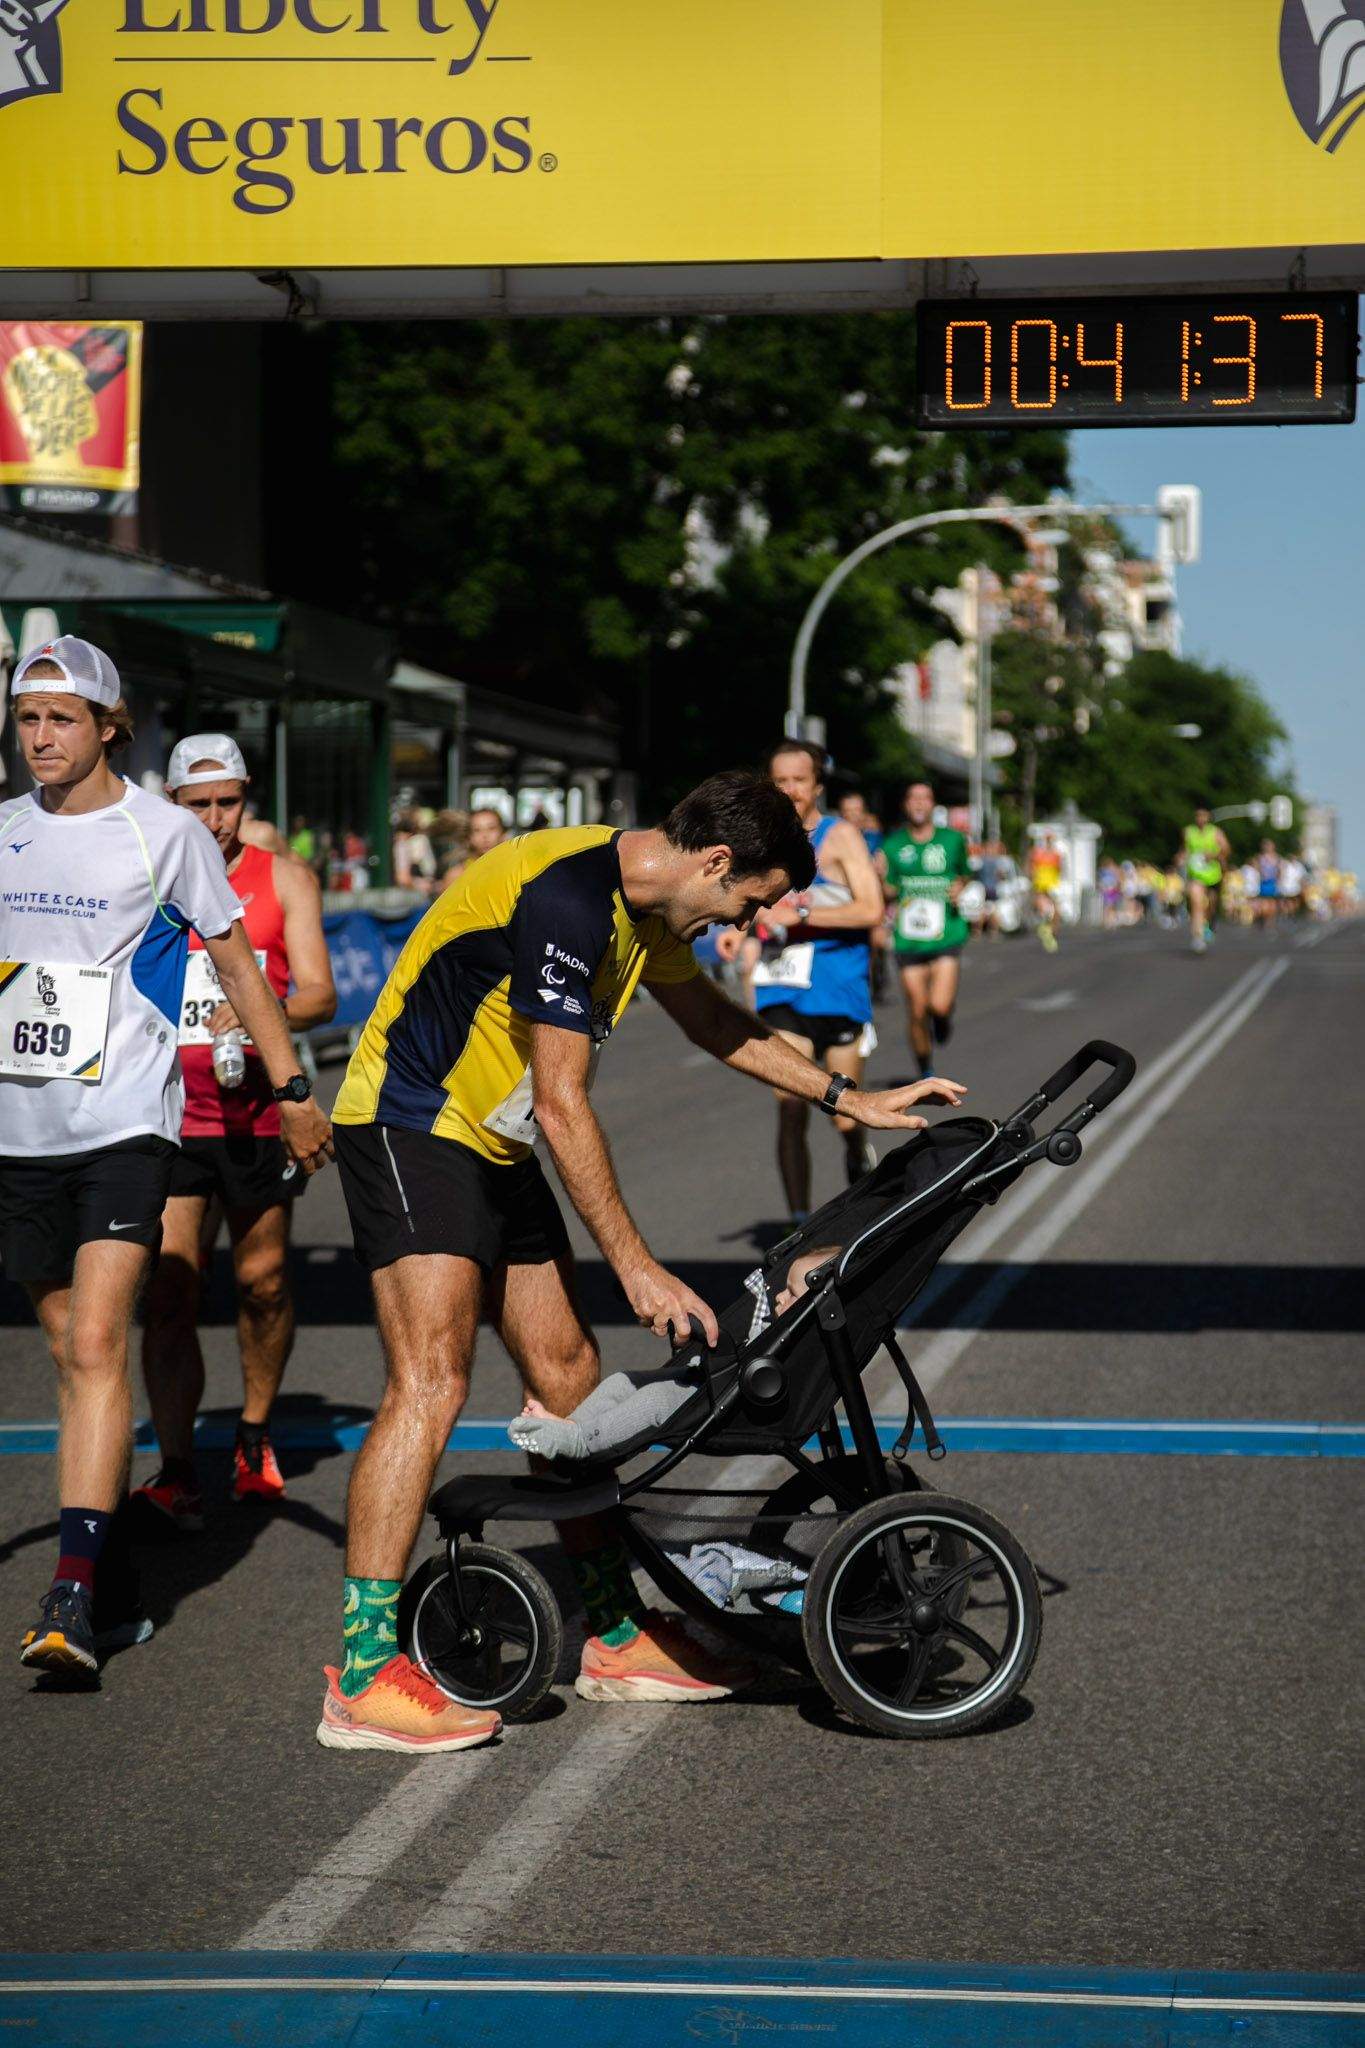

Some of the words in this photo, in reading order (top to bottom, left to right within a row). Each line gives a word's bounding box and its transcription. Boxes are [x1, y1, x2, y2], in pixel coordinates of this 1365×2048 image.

[3, 892, 48, 903] WHITE
[53, 894, 62, 904] &
[65, 895, 109, 910] CASE
[10, 905, 26, 913] THE
[28, 905, 70, 916] RUNNERS
[72, 909, 96, 919] CLUB
[185, 1000, 227, 1027] 33
[13, 1020, 72, 1057] 639
